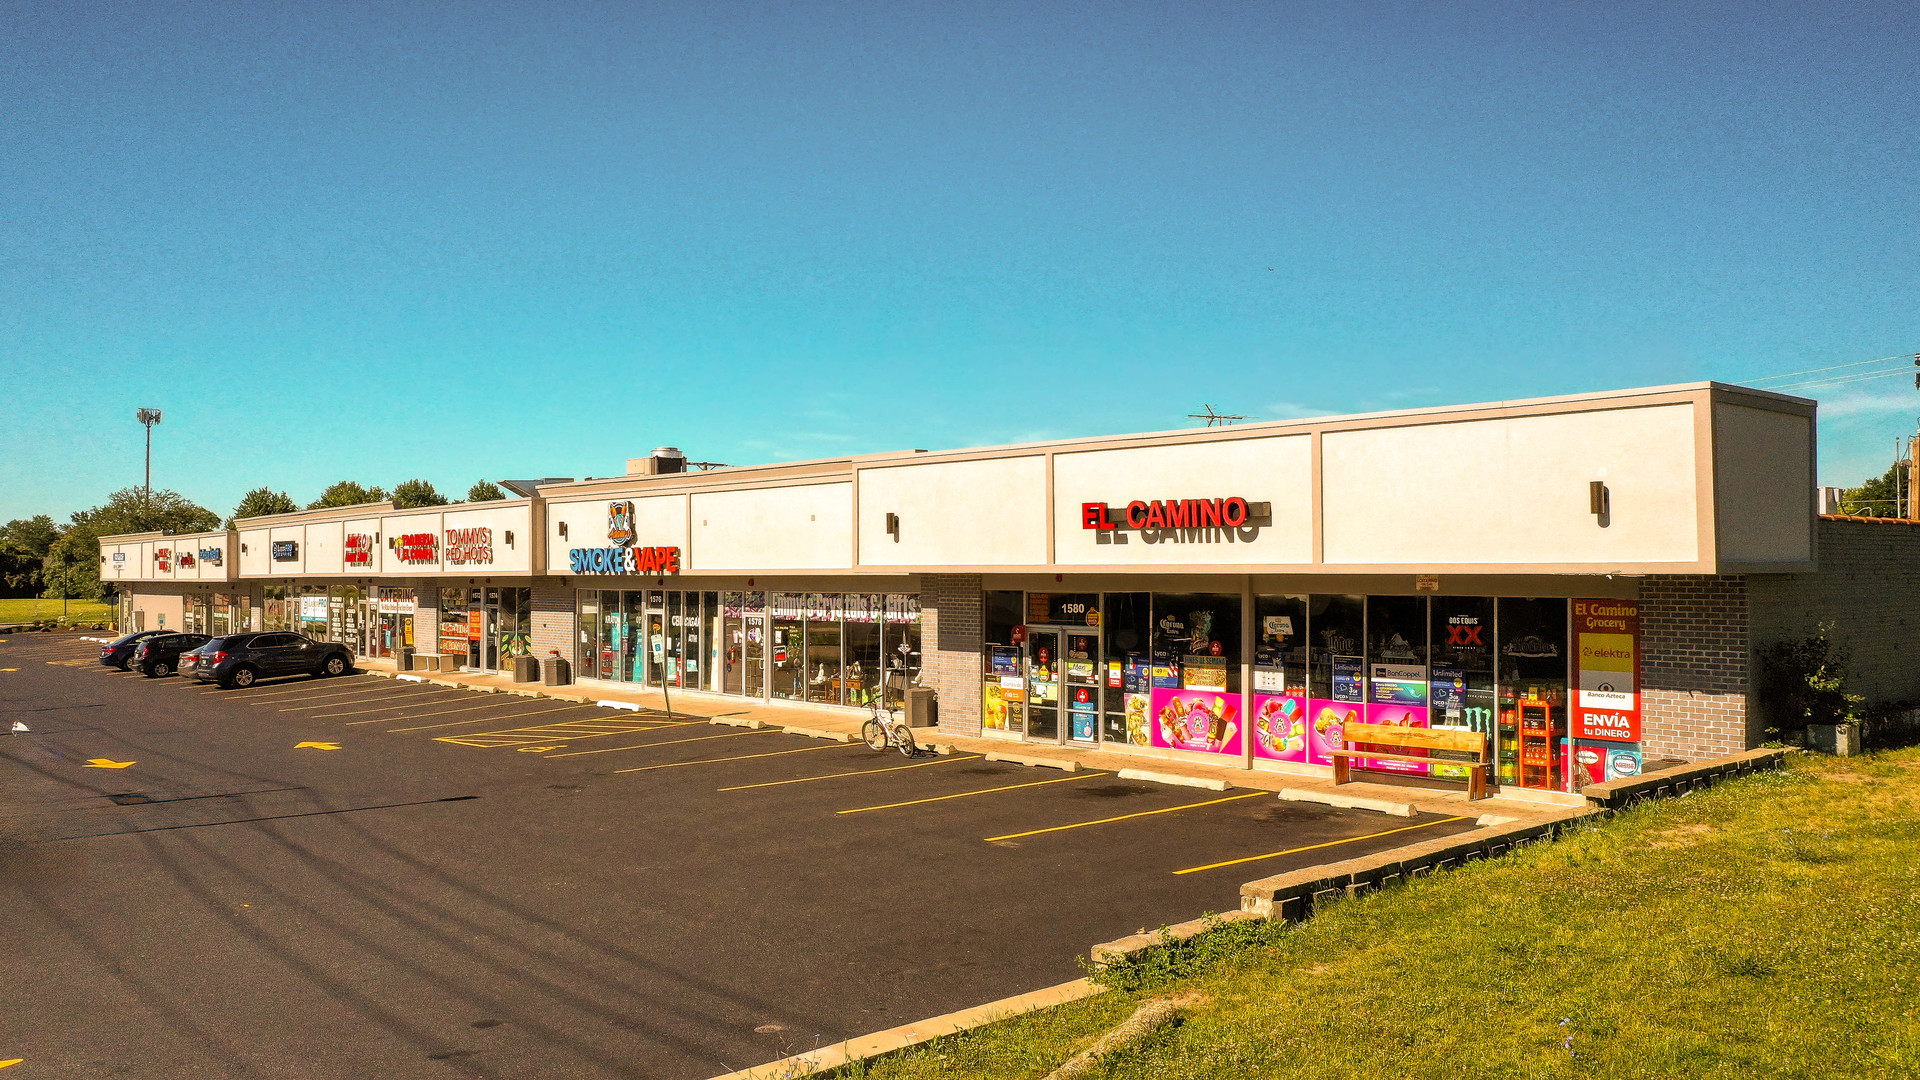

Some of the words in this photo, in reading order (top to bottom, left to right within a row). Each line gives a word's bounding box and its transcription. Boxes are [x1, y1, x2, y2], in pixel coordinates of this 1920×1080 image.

[1082, 502, 1116, 530] EL
[1126, 497, 1249, 530] CAMINO
[445, 527, 488, 546] TOMMY'S
[445, 547, 462, 561] RED
[463, 546, 489, 561] HOTS
[569, 548, 624, 573] SMOKE
[634, 546, 678, 573] VAPE
[1061, 603, 1085, 614] 1580
[1575, 603, 1588, 616] El
[1590, 604, 1638, 617] Camino
[748, 617, 763, 626] 1578
[1159, 618, 1185, 630] Corona
[1449, 616, 1461, 625] DOS
[1461, 616, 1479, 625] EQUIS
[1586, 617, 1626, 631] Grocery
[1447, 624, 1483, 646] XX
[1594, 648, 1631, 659] elektra
[1335, 663, 1362, 672] Unlimited
[1432, 669, 1463, 678] Unlimited
[1387, 669, 1421, 679] BanCoppel
[1583, 712, 1631, 729] ENVÍA
[1583, 727, 1594, 736] tu
[1594, 728, 1631, 739] DINERO
